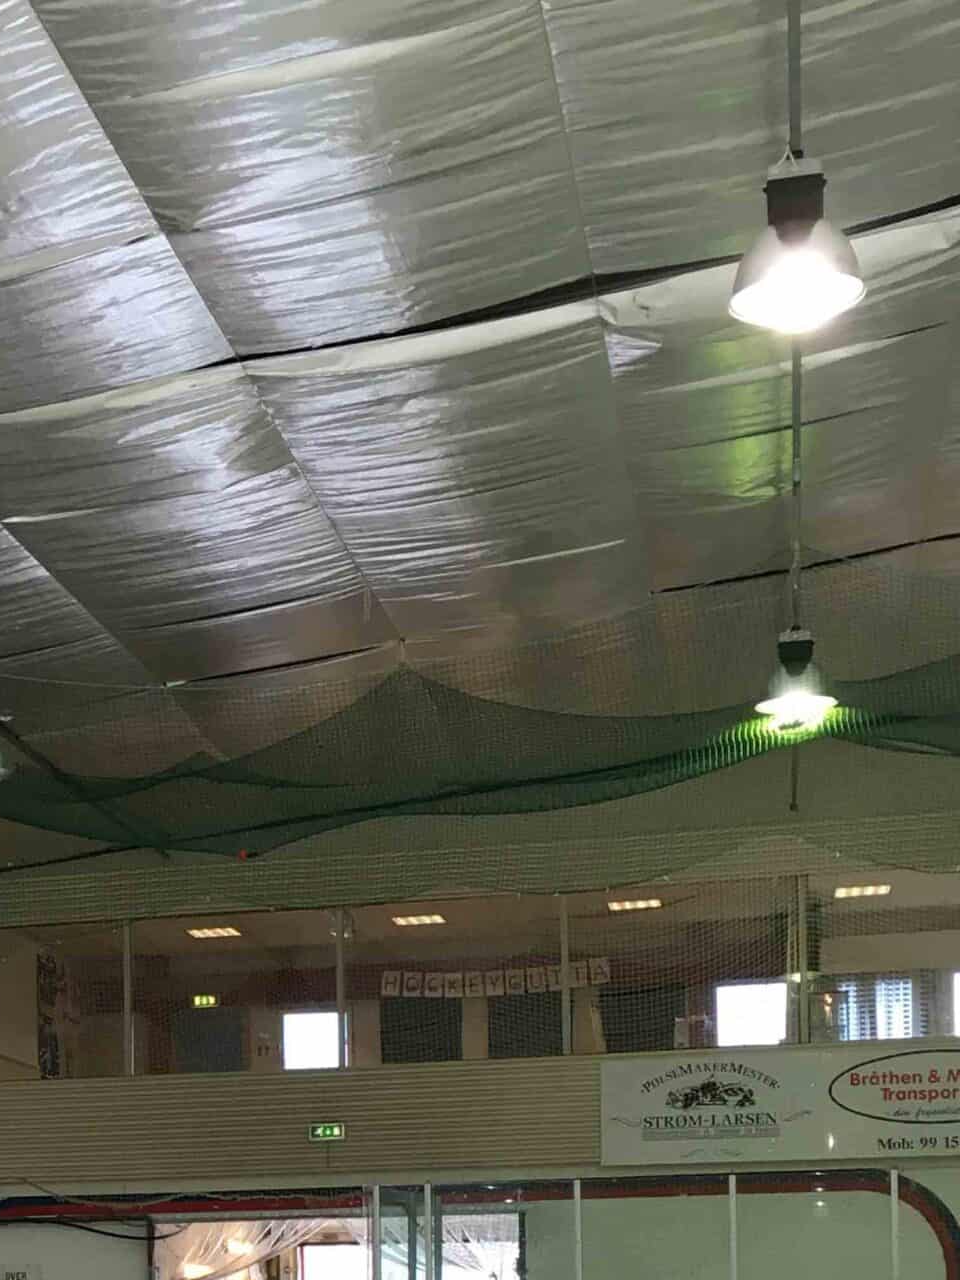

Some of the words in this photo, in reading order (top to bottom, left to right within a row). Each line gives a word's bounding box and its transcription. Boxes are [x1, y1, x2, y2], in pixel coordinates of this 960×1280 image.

[927, 1068, 940, 1084] &
[877, 1137, 915, 1151] Mob:
[920, 1135, 938, 1149] 99
